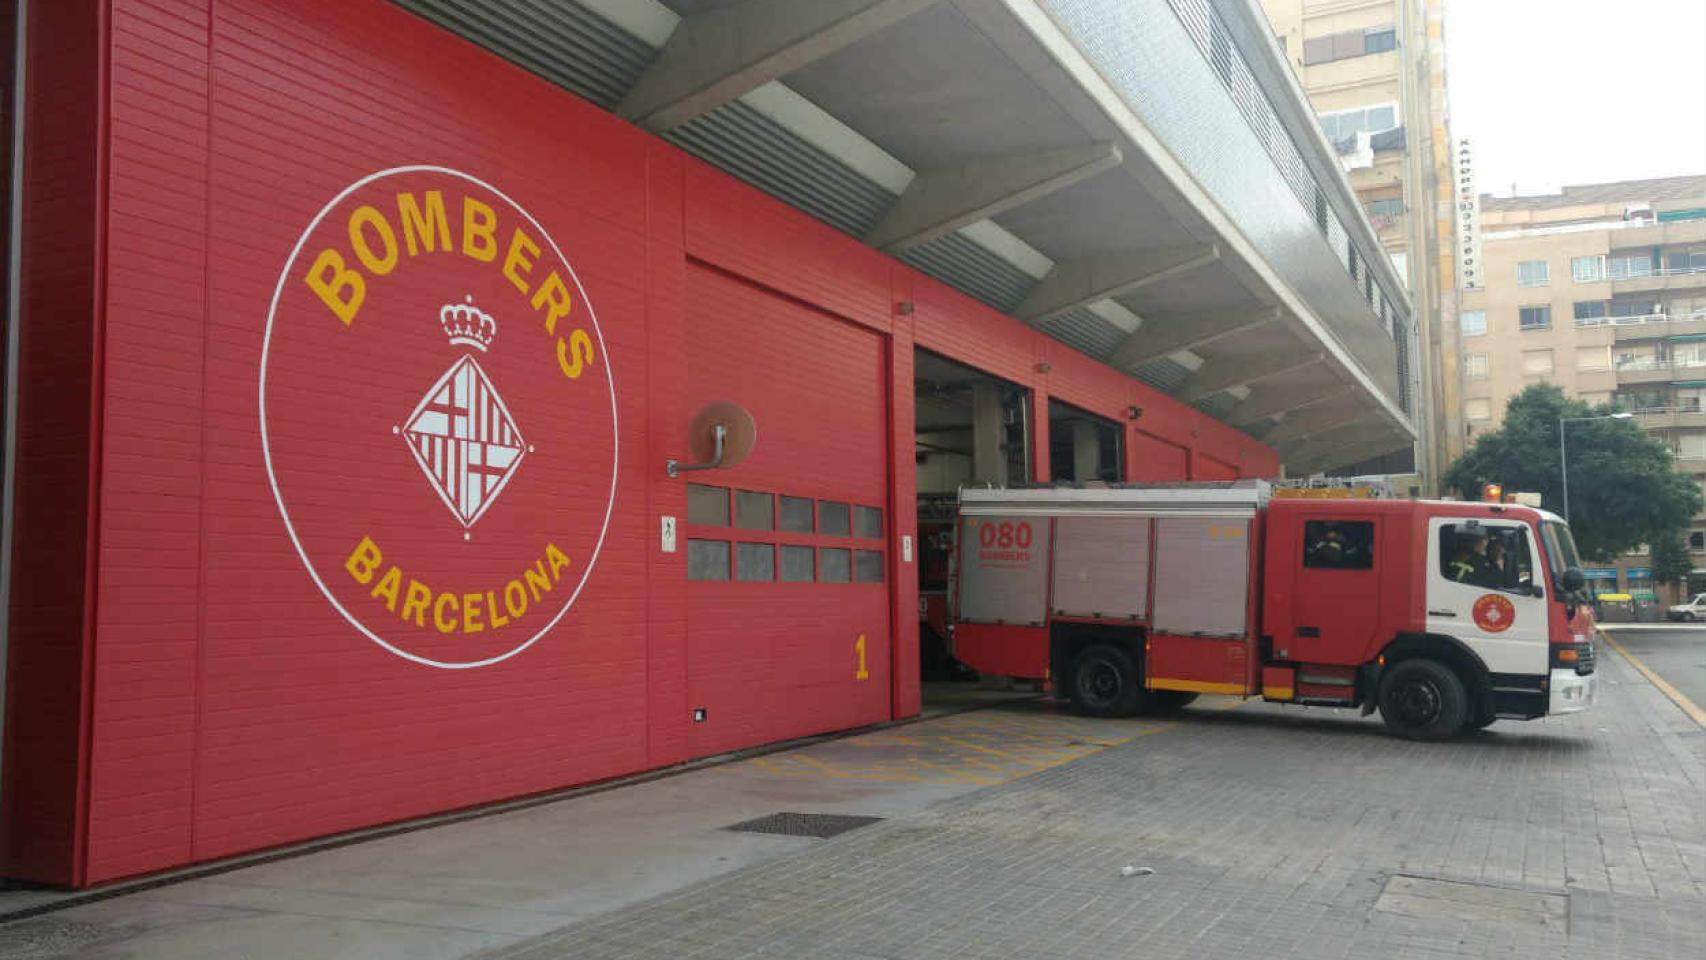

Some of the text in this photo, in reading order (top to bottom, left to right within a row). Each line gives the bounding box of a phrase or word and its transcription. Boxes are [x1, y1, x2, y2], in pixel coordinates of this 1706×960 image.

[305, 190, 594, 380] BOMBERS
[978, 521, 1033, 548] 080
[344, 536, 571, 634] BARCELONA
[855, 634, 869, 681] 1
